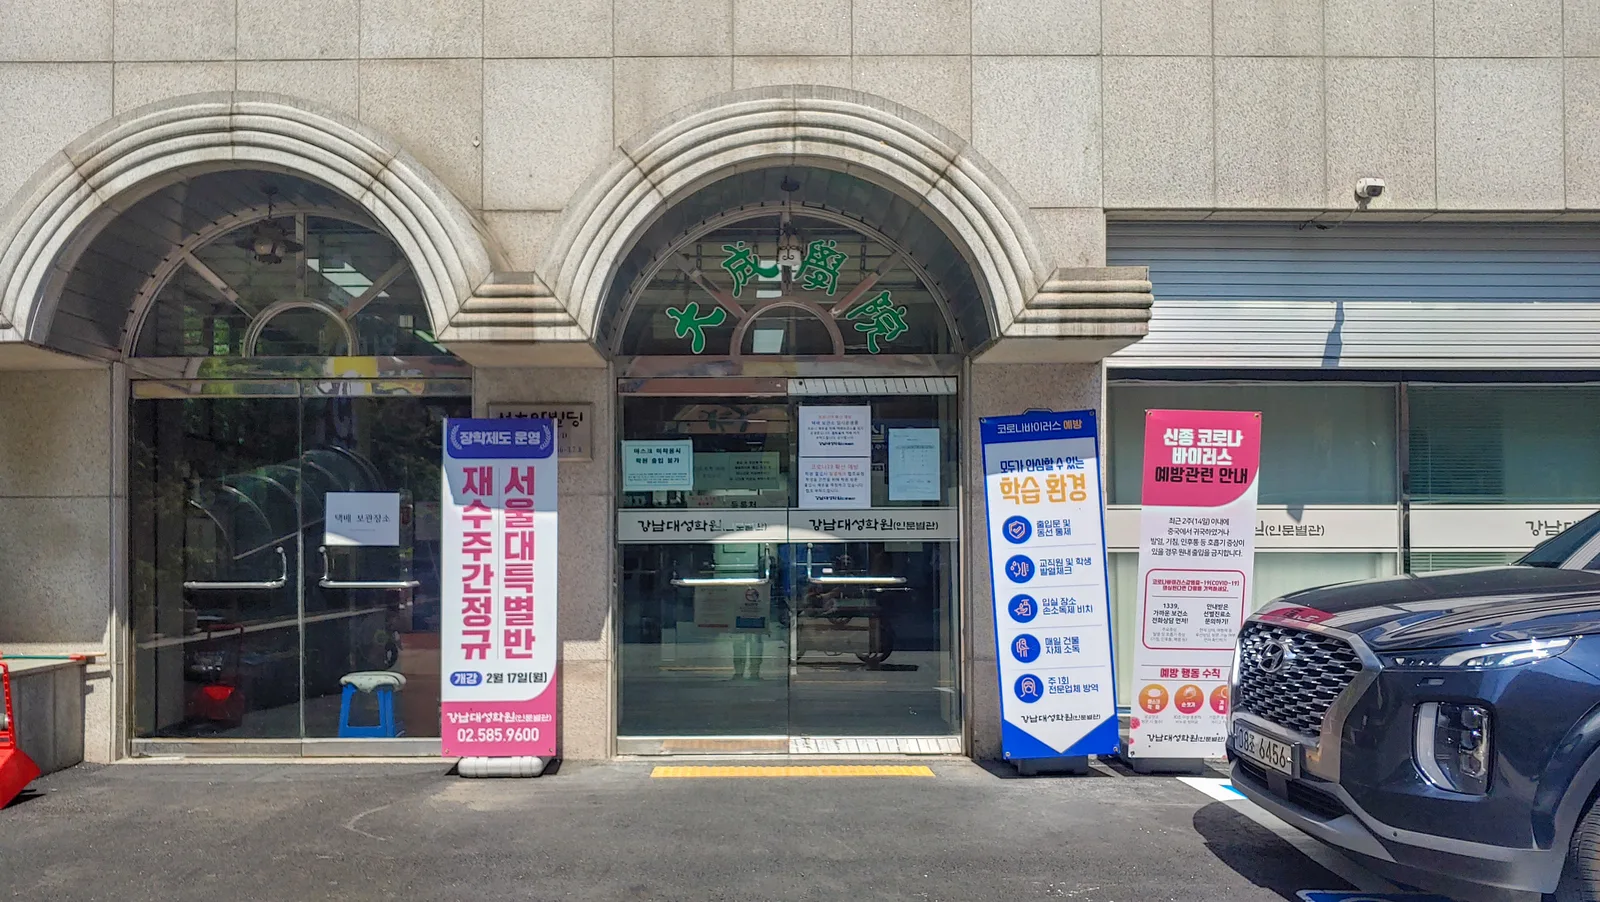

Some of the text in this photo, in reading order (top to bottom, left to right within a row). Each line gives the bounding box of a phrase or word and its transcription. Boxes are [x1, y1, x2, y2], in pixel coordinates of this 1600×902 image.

[997, 419, 1083, 434] 코로나바이러스 예방
[460, 431, 541, 446] 장학제도 운영
[1163, 428, 1244, 447] 신종 코로나
[1171, 447, 1233, 466] 바이러스
[1000, 456, 1085, 474] 모두가 안심할 수 있는
[1155, 466, 1249, 484] 예방관련 안내
[999, 473, 1088, 505] 학습 환경
[334, 513, 391, 524] 택배 보관장소
[1036, 519, 1071, 529] 출입문 및
[1168, 517, 1181, 526] 최근
[1210, 517, 1230, 526] 이내에
[808, 518, 939, 532] 강남대성학원(인문별관)
[1037, 528, 1072, 537] 동선 통제
[1167, 527, 1192, 536] 중국에서
[1200, 539, 1207, 547] 등
[1207, 539, 1226, 547] 호흡기
[1226, 539, 1245, 547] 증상이
[461, 466, 494, 660] 재수주간정규
[504, 466, 536, 660] 서울대특별반
[1039, 556, 1092, 568] 교직원 및 학생
[1040, 567, 1073, 576] 발열체크
[1042, 597, 1077, 607] 입실 장소
[1043, 604, 1094, 615] 손소독제 비치
[1045, 636, 1080, 646] 매일 건물
[1046, 645, 1080, 655] 자체 소독
[453, 671, 548, 686] 개강 2월 17일(월)
[1160, 667, 1221, 679] 예방 행동 수칙
[1048, 676, 1070, 686] 주 1회
[1048, 683, 1099, 694] 전문업체 방역
[457, 727, 540, 743] 02.585.9600
[1259, 738, 1287, 768] 6456
